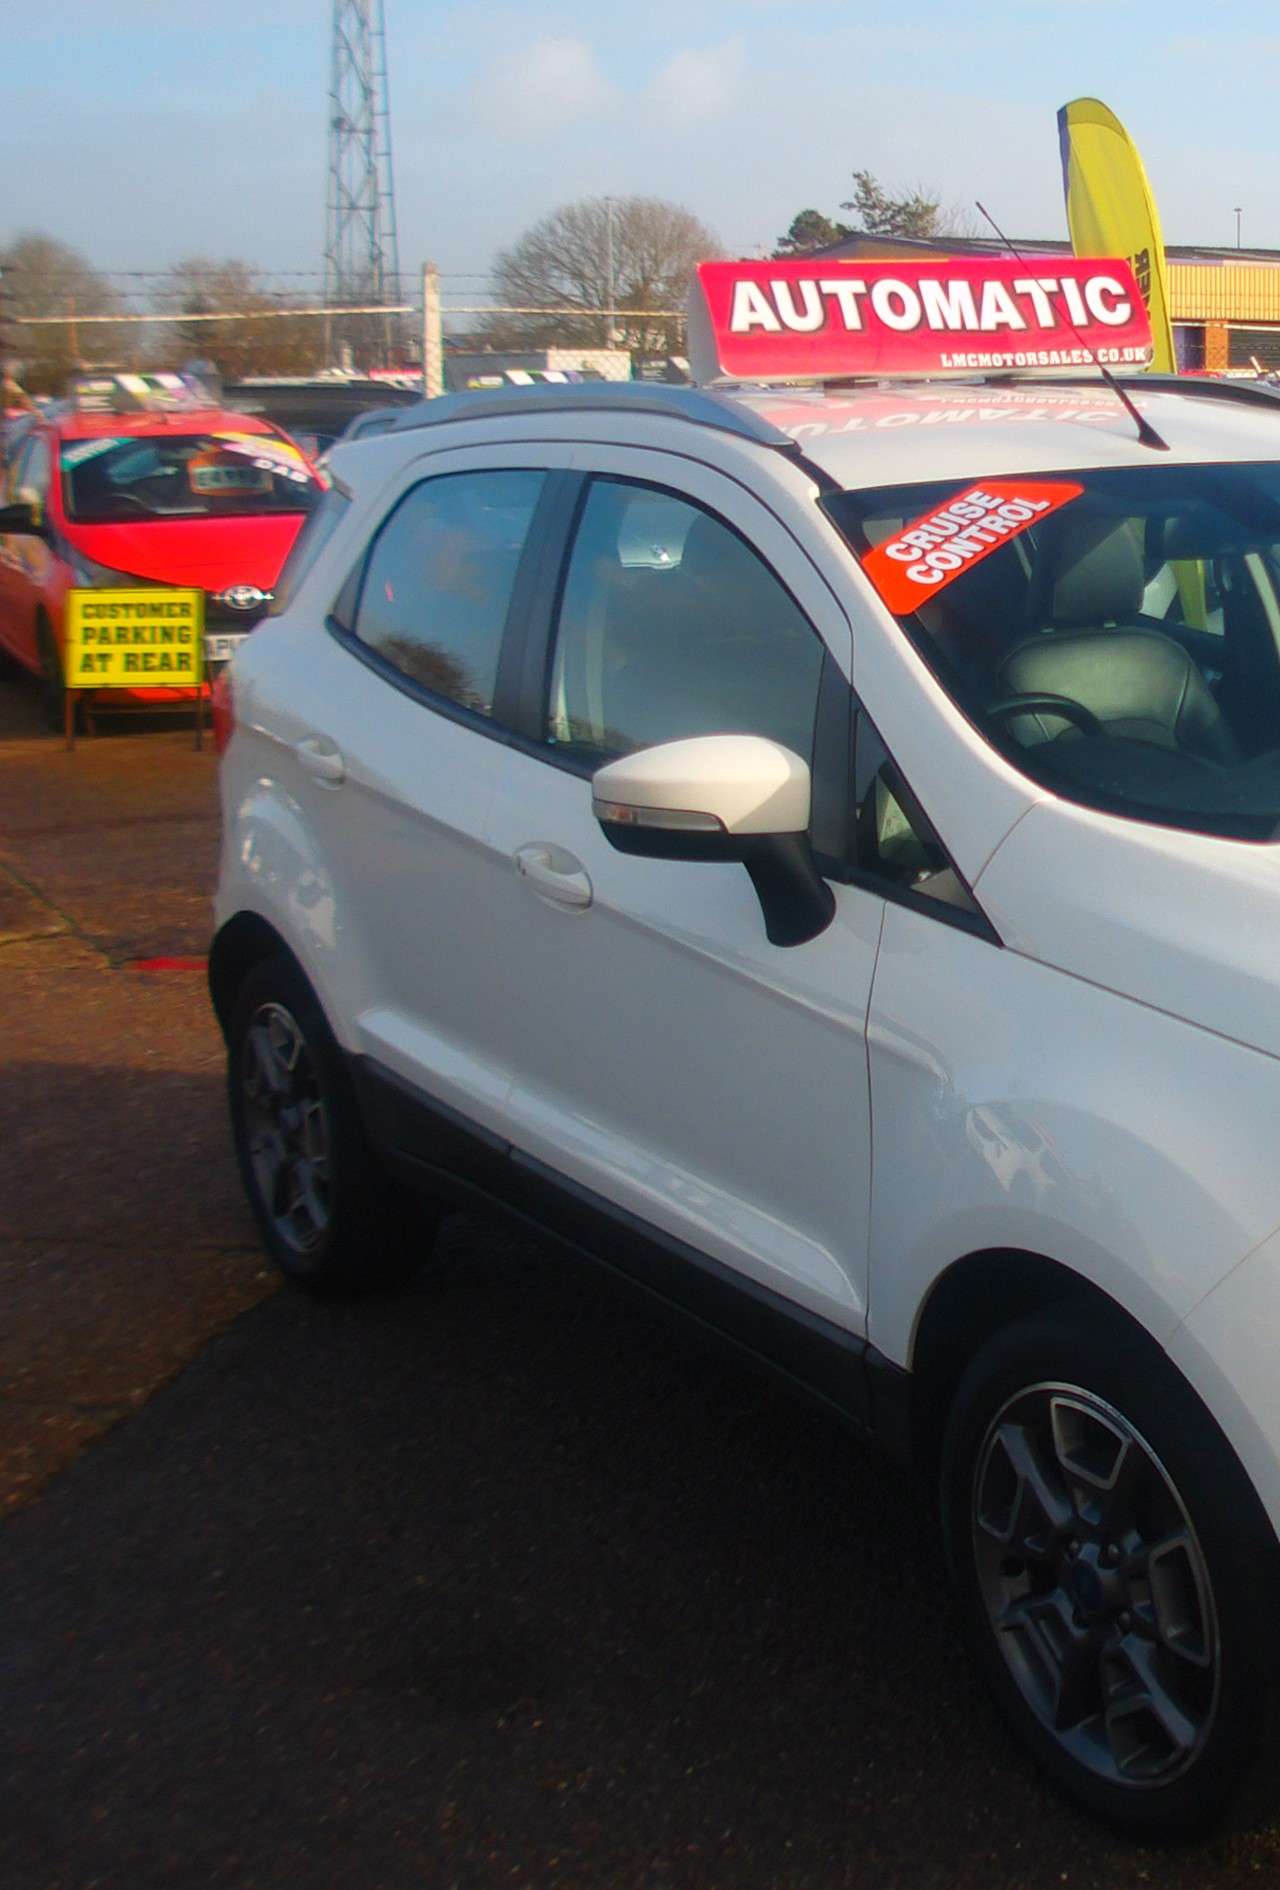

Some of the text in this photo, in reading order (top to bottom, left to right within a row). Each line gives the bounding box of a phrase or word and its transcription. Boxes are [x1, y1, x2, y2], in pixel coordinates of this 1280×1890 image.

[730, 275, 1132, 333] AUTOMATIC
[940, 347, 1146, 368] LMCMOTORSALESCO.UK
[885, 491, 1005, 562] CRUISE
[906, 497, 1050, 585] CONTROL
[81, 602, 192, 619] CUSTOMER
[81, 625, 192, 645] PARKING
[80, 652, 192, 672] AT REAR
